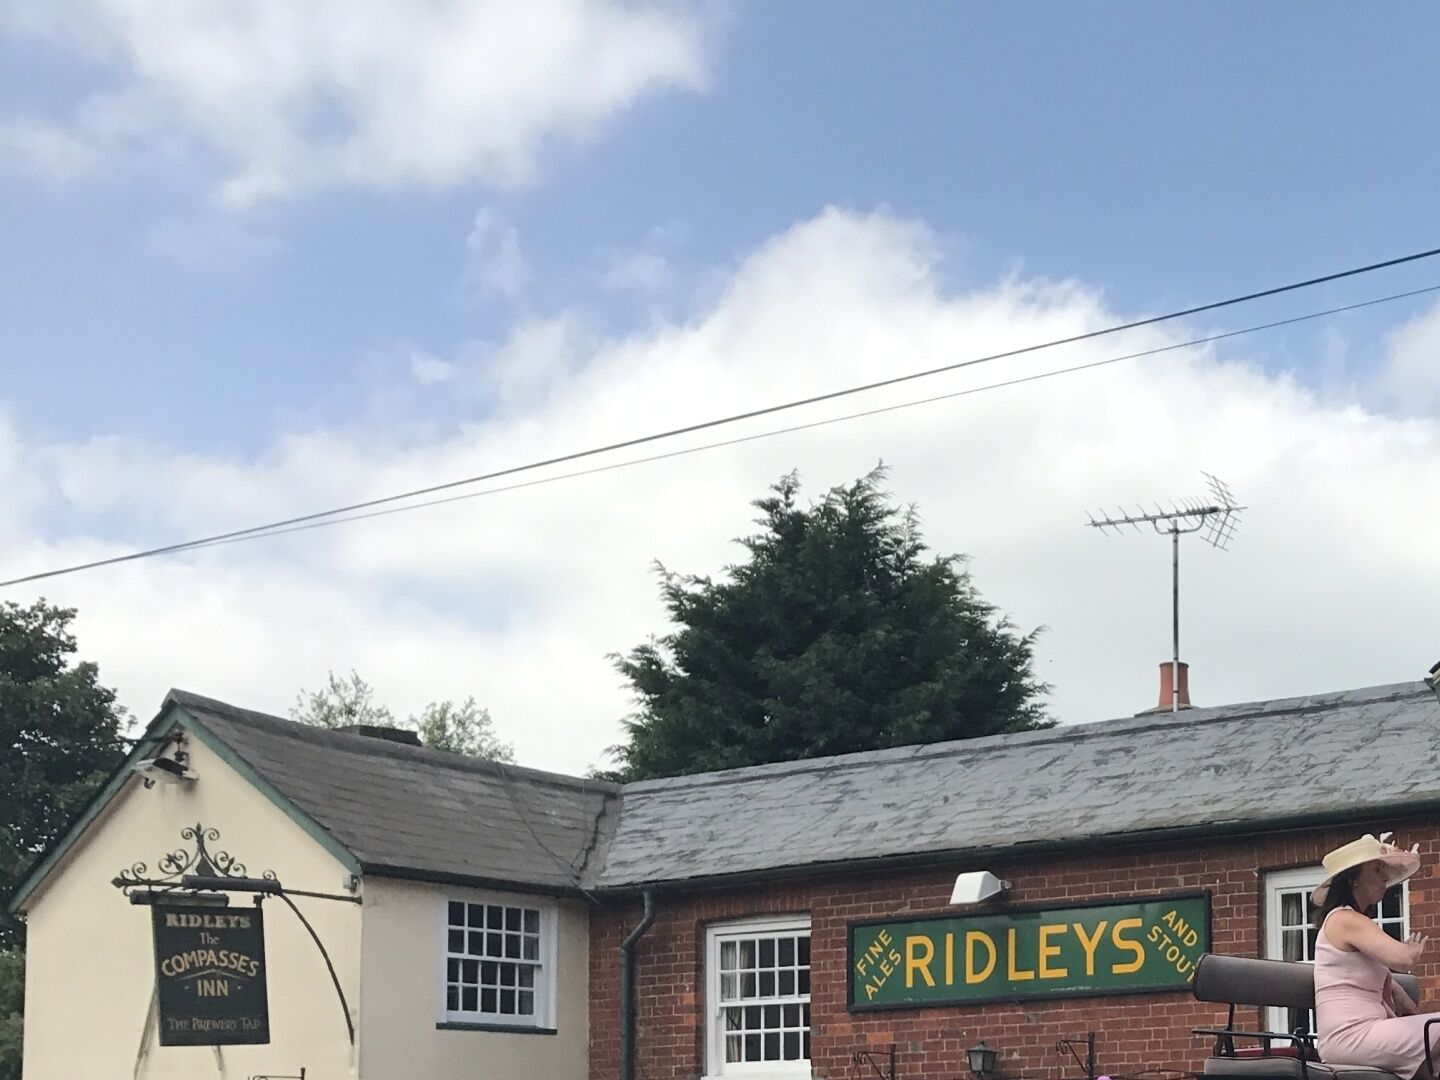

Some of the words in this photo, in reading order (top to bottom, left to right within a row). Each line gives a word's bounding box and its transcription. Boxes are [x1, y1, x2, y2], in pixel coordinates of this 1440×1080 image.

[166, 913, 250, 929] RIDLEYS
[1161, 909, 1198, 947] AND
[200, 932, 220, 946] The
[856, 928, 893, 977] FINE
[906, 918, 1146, 988] RIDLEYS
[161, 949, 260, 978] COMPASSES
[864, 949, 903, 1001] ALES
[197, 980, 229, 997] INN
[192, 1017, 237, 1031] BREWERY
